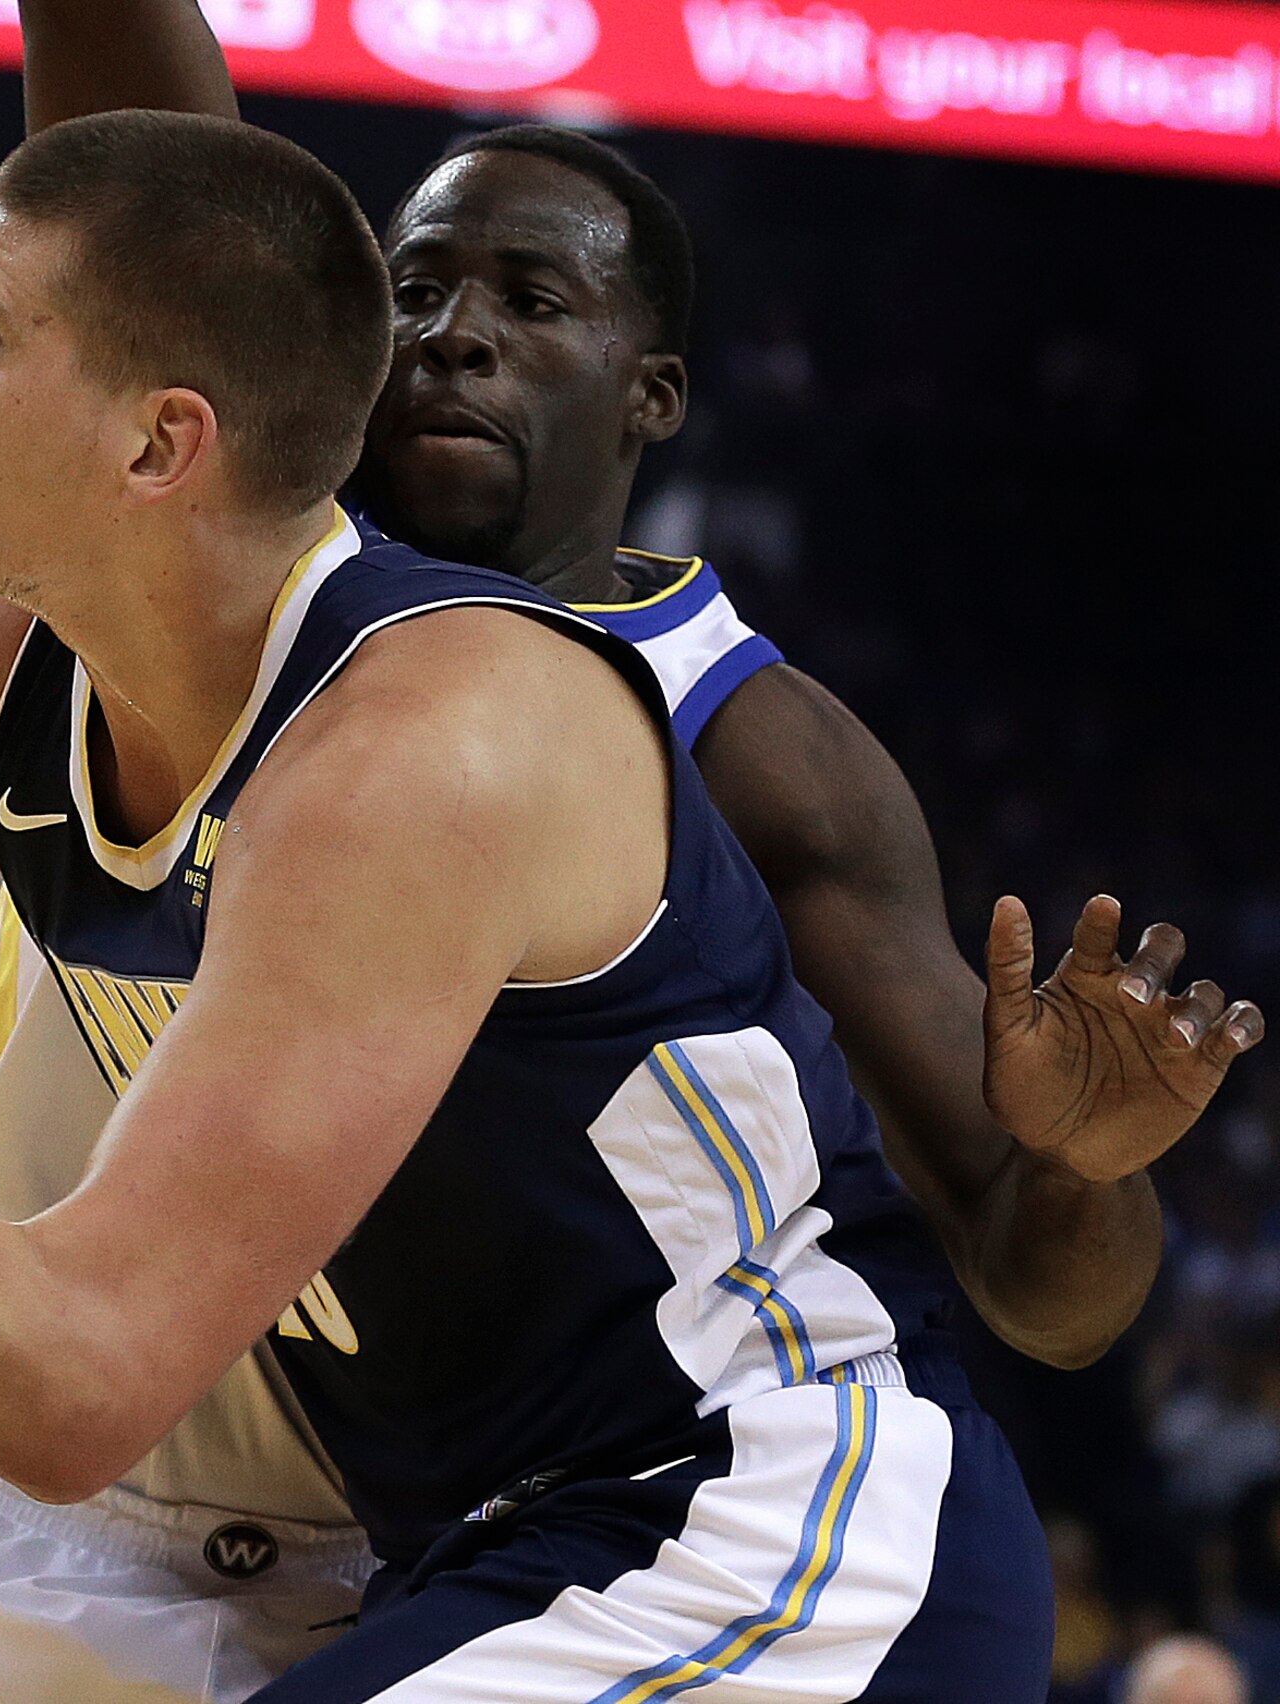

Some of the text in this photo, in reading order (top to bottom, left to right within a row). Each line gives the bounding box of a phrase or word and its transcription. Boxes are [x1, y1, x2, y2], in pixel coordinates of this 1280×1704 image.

[683, 0, 872, 100] Visit
[875, 28, 1068, 120] your
[1080, 28, 1272, 136] local
